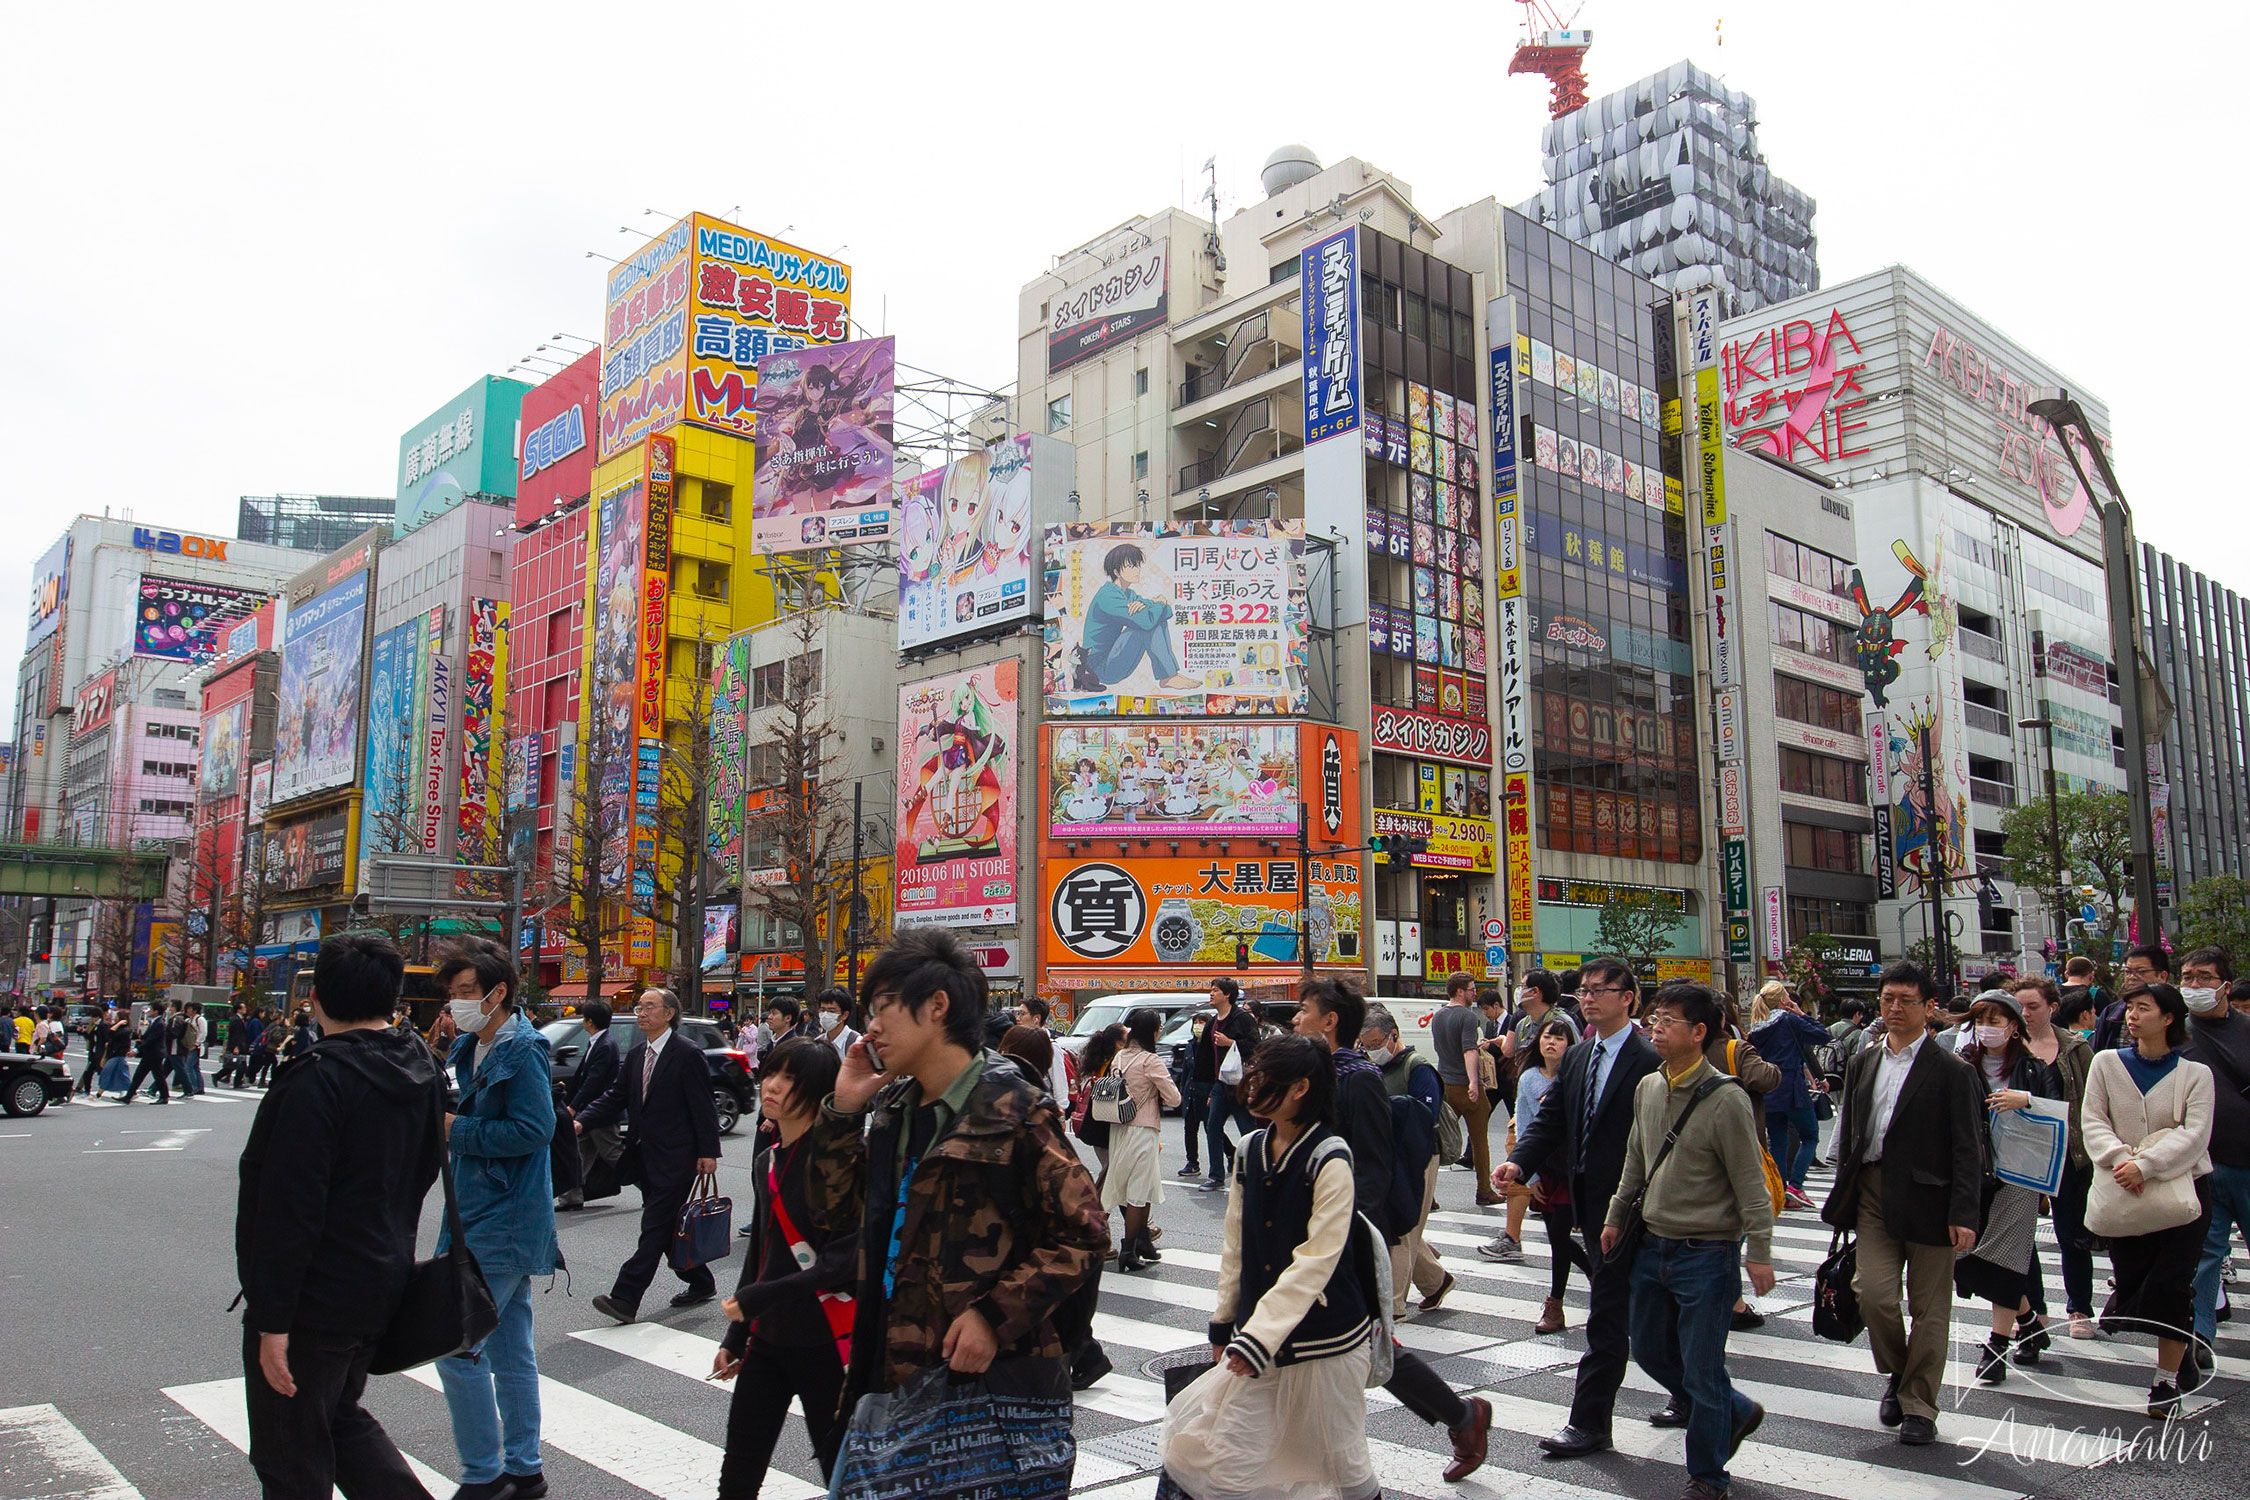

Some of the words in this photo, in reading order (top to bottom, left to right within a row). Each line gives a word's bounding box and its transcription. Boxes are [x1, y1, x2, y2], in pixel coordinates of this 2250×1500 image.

[608, 220, 690, 307] MEDIAリサイクル
[699, 226, 848, 293] MEDIAリサイクル
[607, 258, 687, 349] 激安販売
[699, 262, 847, 343] 激安販売
[1055, 256, 1160, 331] メイドカジノ
[1079, 330, 1100, 348] POKER
[1696, 297, 1713, 363] スーパービル
[604, 310, 685, 401] 高額買取
[1307, 366, 1319, 421] 秋葉原店
[707, 411, 755, 433] ムーラン
[1700, 401, 1713, 443] Yellow
[523, 403, 587, 481] SEGA
[1388, 441, 1407, 465] 7F
[651, 484, 669, 494] DVD
[1646, 482, 1663, 500] 3.16
[1665, 485, 1683, 497] GAME
[1703, 452, 1716, 518] Submarine
[650, 502, 668, 513] ゲーム
[652, 513, 665, 522] CD
[1501, 501, 1513, 513] 3F
[649, 522, 667, 532] アイドル
[830, 517, 855, 526] アズレン
[1709, 526, 1723, 536] 5F
[648, 531, 667, 541] アニメ
[649, 541, 666, 551] コミック
[1389, 533, 1409, 557] 6F
[1503, 519, 1513, 568] りらくる
[648, 550, 665, 560] ホビー
[1174, 546, 1281, 572] 同居人はひざ、
[1565, 531, 1625, 574] 秋葉館
[1711, 545, 1725, 590] 秋葉館
[1175, 610, 1217, 625] 第1巻
[1218, 603, 1270, 624] 3.22
[1822, 598, 1840, 614] cafe
[1392, 630, 1412, 653] 5F
[433, 658, 449, 712] AKKY
[1504, 601, 1525, 750] 喫茶室ルノアール
[1417, 691, 1436, 704] Stars
[1374, 711, 1489, 760] メイドカジノ
[1721, 695, 1735, 758] amiami
[1802, 731, 1824, 747] @home
[1824, 737, 1837, 750] cafe
[560, 743, 574, 781] SEGA
[640, 751, 657, 761] DVD
[902, 719, 913, 793] ムラサメ
[1873, 740, 1884, 774] @home
[1422, 768, 1434, 780] 3F
[1876, 775, 1885, 795] cafe
[638, 796, 657, 805] DVD
[1420, 784, 1436, 795] 入口
[1724, 769, 1740, 825] あみあみ
[1507, 777, 1528, 837] 免税
[1551, 802, 1565, 812] Tax
[1551, 813, 1567, 824] Free
[425, 804, 443, 850] Shop
[1377, 815, 1432, 834] 全身もみほぐし
[1449, 821, 1486, 843] 2,980
[1485, 833, 1494, 843] 円
[1519, 839, 1530, 873] TAX
[1876, 809, 1893, 896] GALLERIA
[901, 865, 947, 885] 2019.06
[952, 863, 965, 880] IN
[969, 858, 1011, 878] STORE
[1152, 881, 1193, 896] チケット
[1199, 861, 1298, 894] 大黒屋
[1310, 860, 1359, 884] 質&買取
[1728, 846, 1744, 906] リバティー
[634, 884, 654, 894] DVD
[901, 886, 937, 902] amiami
[1521, 877, 1532, 921] FREE
[934, 914, 947, 922] Anime
[948, 913, 960, 922] goods
[961, 912, 969, 920] and
[1061, 878, 1136, 947] 質
[1770, 904, 1778, 938] @home
[1487, 923, 1501, 935] 40
[1736, 926, 1745, 937] P
[632, 940, 651, 949] AKIBA
[1772, 939, 1780, 959] cafe
[1464, 952, 1477, 967] TAX
[1489, 951, 1498, 964] P
[1849, 967, 1865, 978] Lounge
